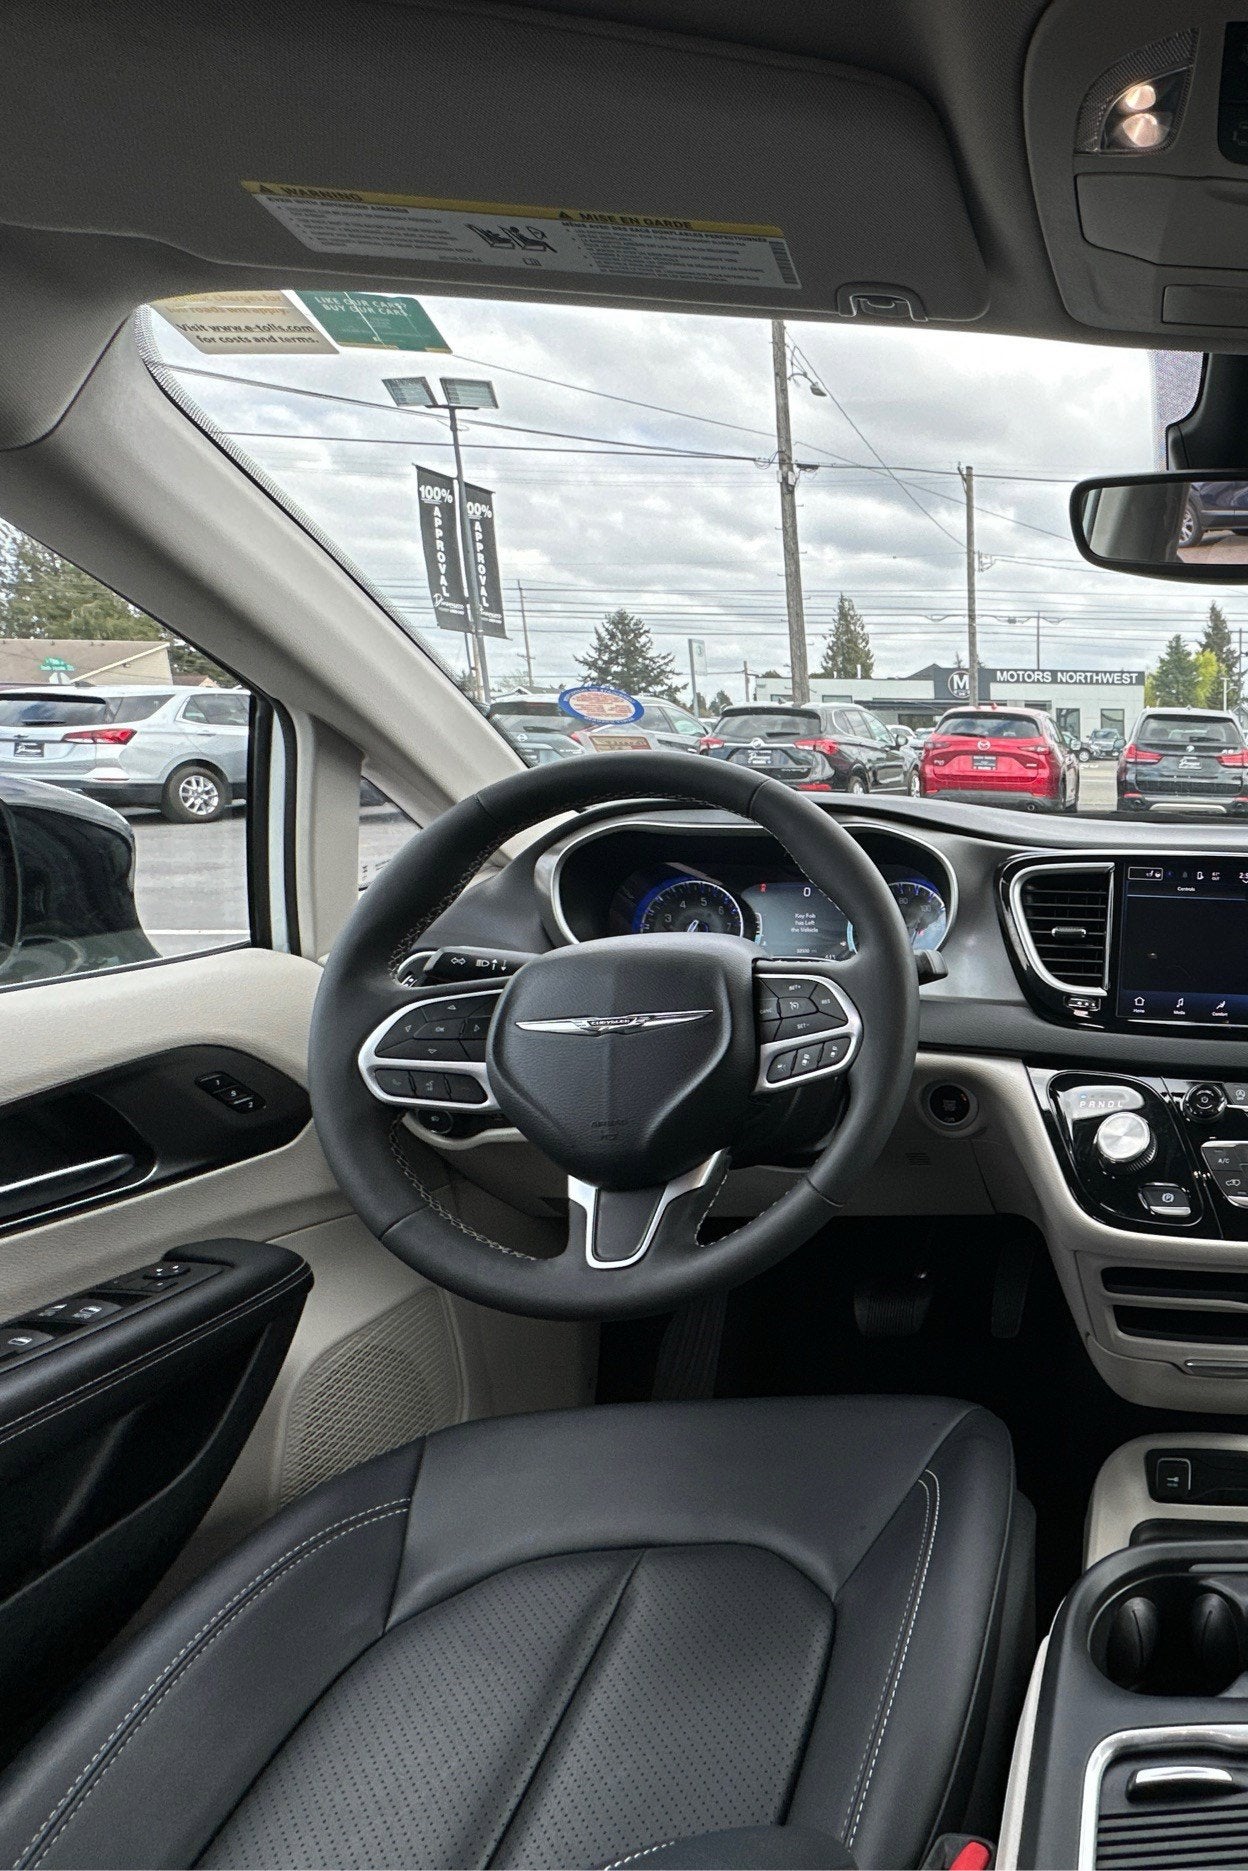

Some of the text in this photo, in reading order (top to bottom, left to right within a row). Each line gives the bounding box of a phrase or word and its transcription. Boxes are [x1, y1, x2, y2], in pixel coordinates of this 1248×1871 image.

[578, 211, 693, 230] MISE EN GARDE
[314, 296, 341, 305] LIKE
[344, 298, 367, 307] OUR
[322, 303, 347, 312] BUY
[350, 305, 377, 314] OUR
[177, 323, 315, 333] Visit www.e-tolls.com
[196, 334, 320, 344] for costs and terms.
[419, 485, 453, 504] 100%
[433, 506, 450, 597] APPROVAL
[474, 521, 490, 607] APPROVAL
[996, 671, 1138, 684] MOTORS NORTHWEST
[803, 887, 811, 897] 0
[680, 900, 687, 909] 4
[701, 898, 707, 906] 5
[718, 906, 724, 914] 6
[664, 914, 672, 923] 3
